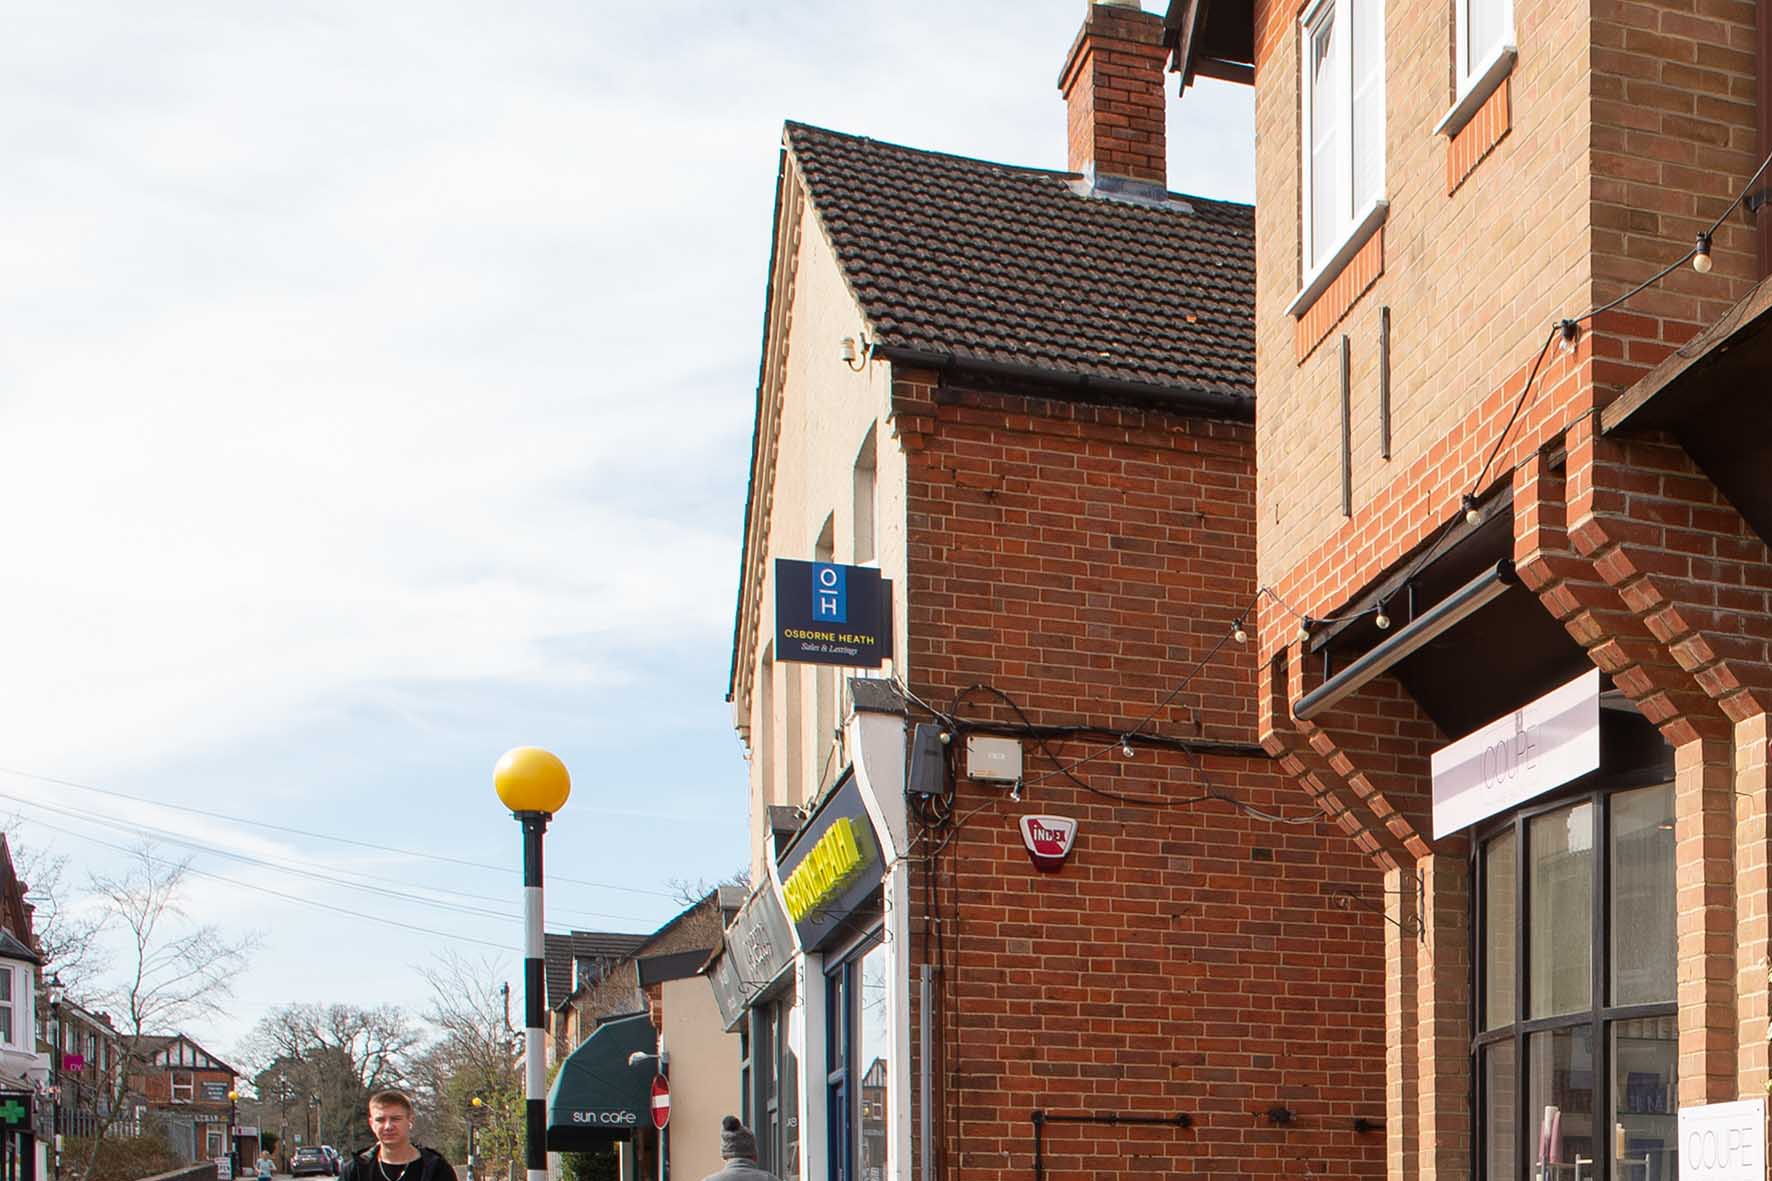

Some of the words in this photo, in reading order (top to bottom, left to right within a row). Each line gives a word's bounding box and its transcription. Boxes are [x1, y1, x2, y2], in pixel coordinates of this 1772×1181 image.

[784, 628, 836, 642] OSBORNE
[838, 634, 875, 645] HEATH
[572, 1111, 597, 1122] sun
[600, 1110, 637, 1124] cafe
